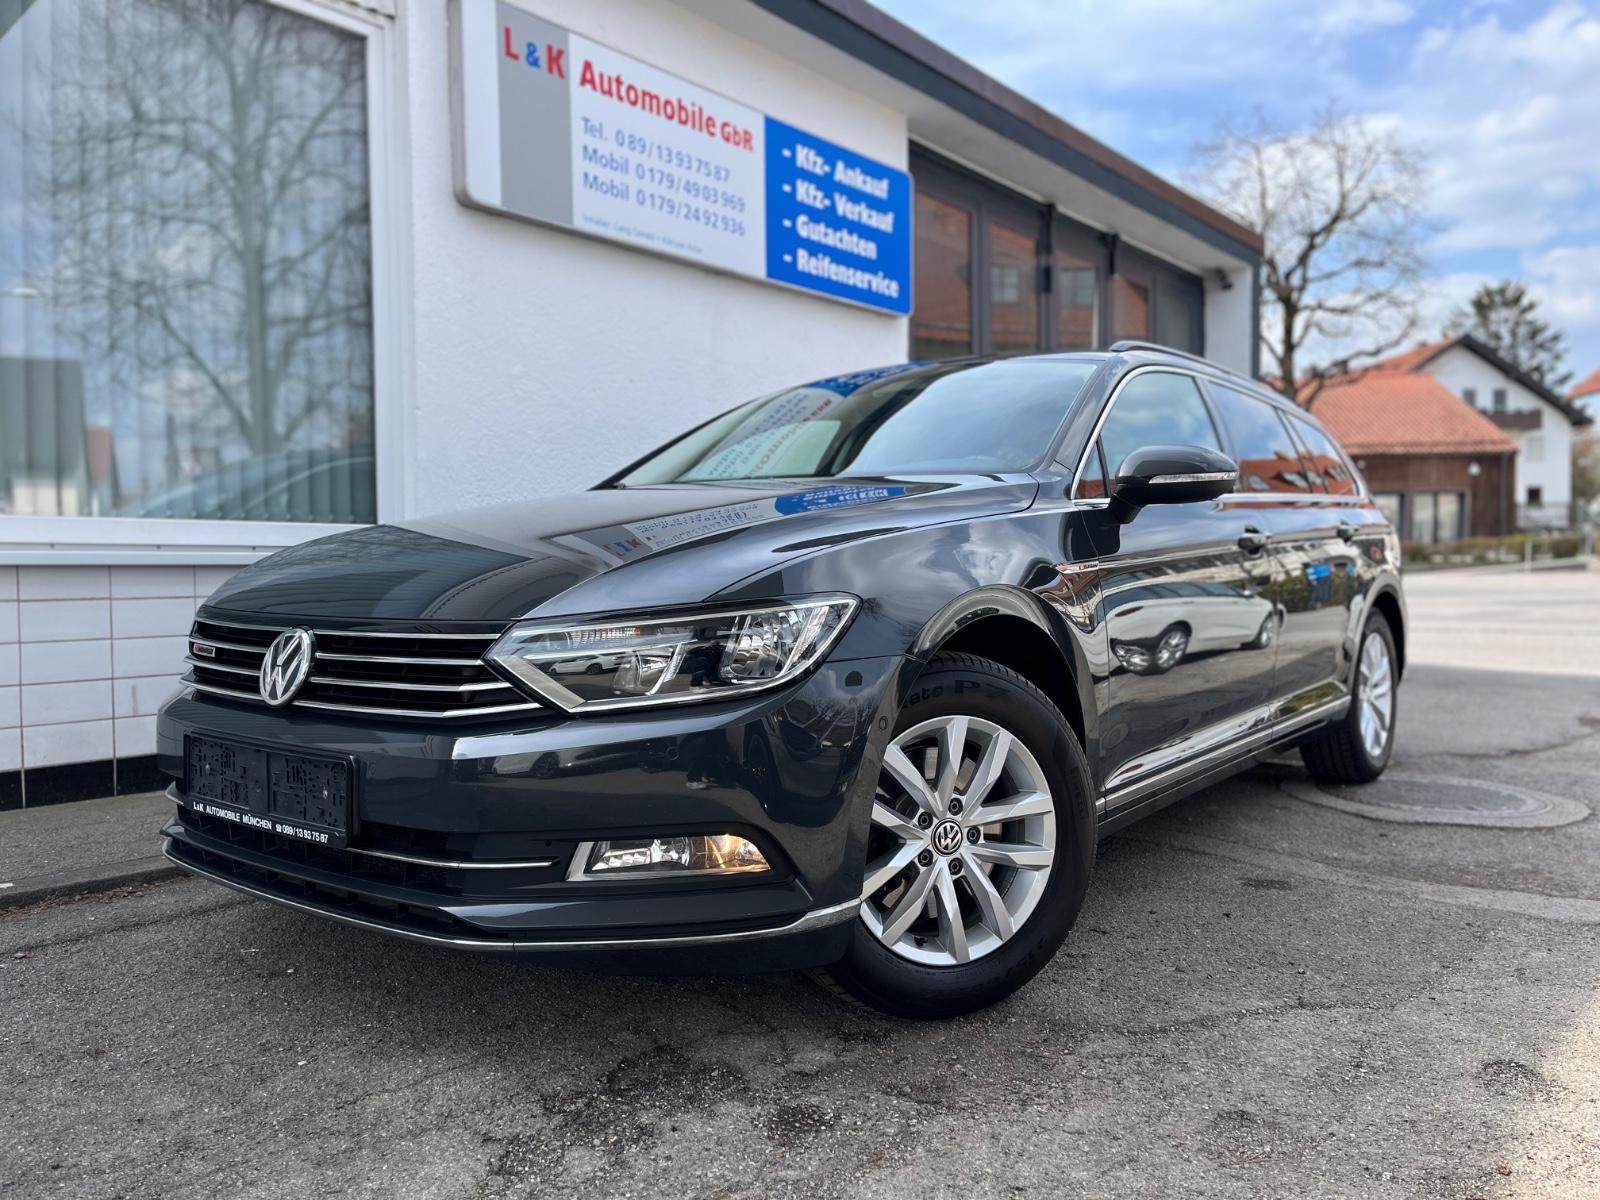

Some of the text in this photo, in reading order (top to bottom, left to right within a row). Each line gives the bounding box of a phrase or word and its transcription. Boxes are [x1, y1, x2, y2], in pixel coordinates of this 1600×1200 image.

[503, 26, 567, 79] L & K
[579, 59, 754, 153] Automobile GbR
[581, 117, 609, 142] Tel.
[582, 145, 630, 175] Mobil
[833, 160, 890, 200] Ankauf
[583, 171, 630, 201] Mobil
[833, 192, 895, 234] Verkauf
[795, 214, 878, 260] Gutachten
[796, 248, 900, 299] Reifenservice
[206, 805, 241, 822] AUTOMOBILE
[242, 813, 272, 830] MÜNCHEN
